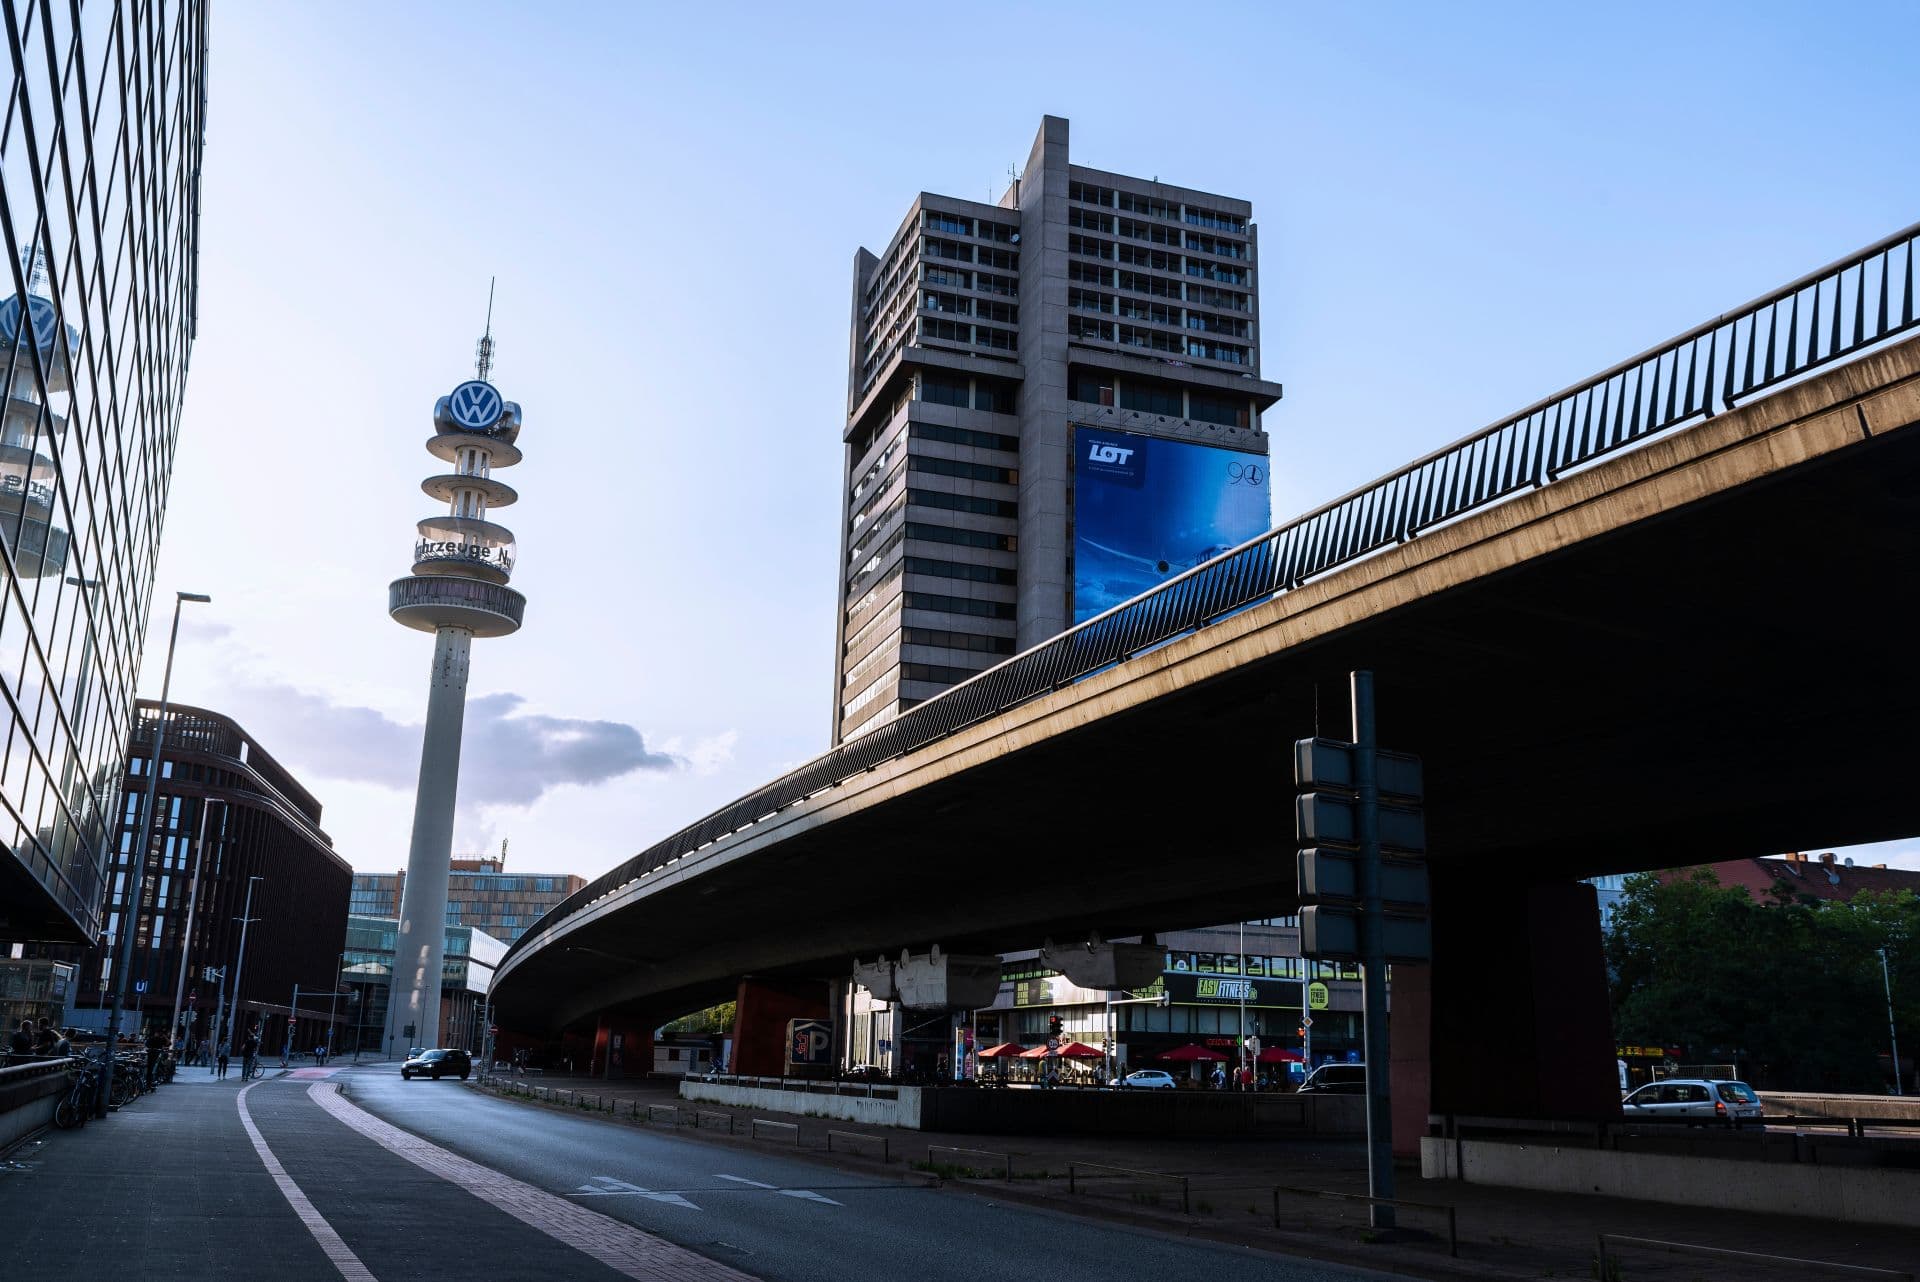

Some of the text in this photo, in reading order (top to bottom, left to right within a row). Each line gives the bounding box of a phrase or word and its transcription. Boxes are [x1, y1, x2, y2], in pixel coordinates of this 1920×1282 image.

[454, 384, 500, 426] VW
[1089, 444, 1134, 465] LOT
[417, 538, 491, 559] hrzeuge
[136, 982, 145, 992] U
[1198, 979, 1219, 997] EASY
[809, 1030, 829, 1060] P
